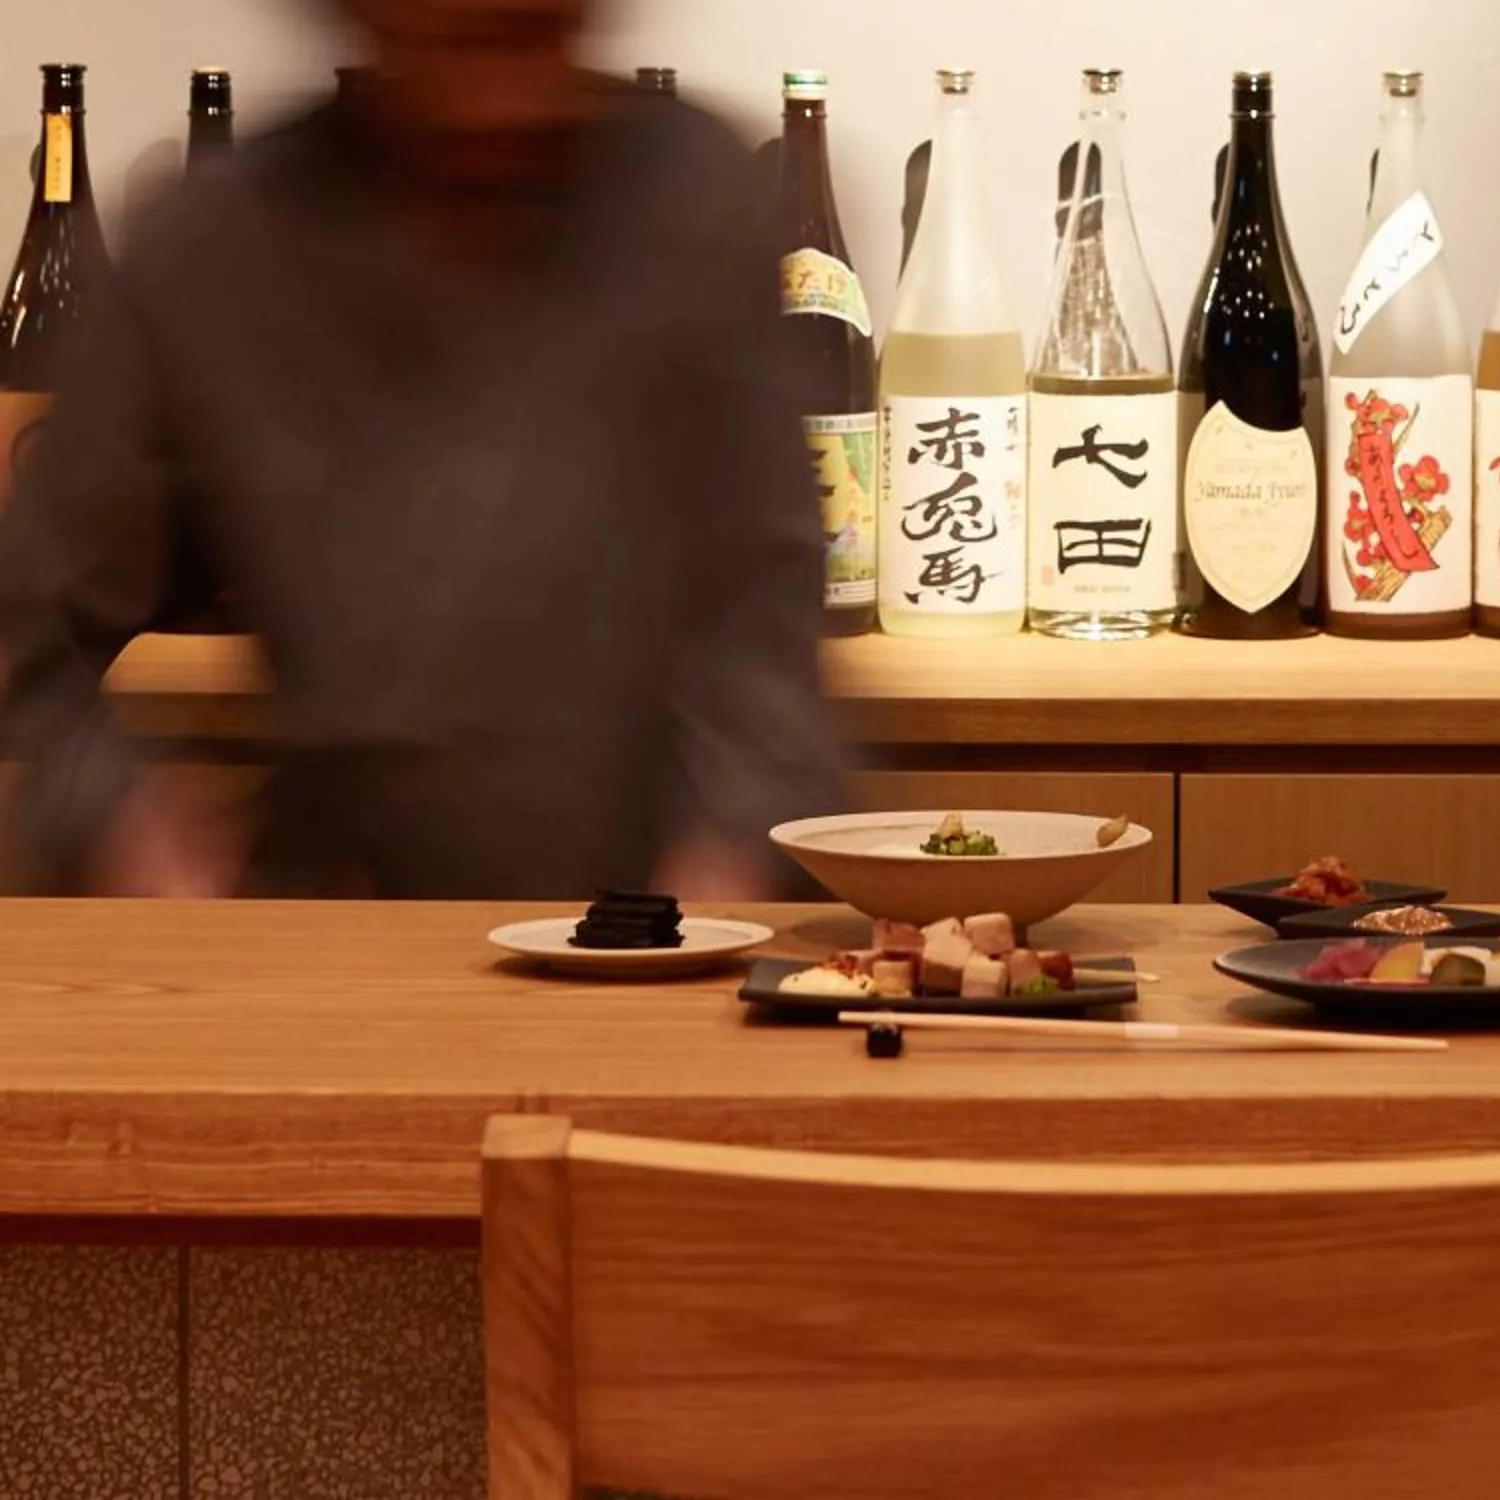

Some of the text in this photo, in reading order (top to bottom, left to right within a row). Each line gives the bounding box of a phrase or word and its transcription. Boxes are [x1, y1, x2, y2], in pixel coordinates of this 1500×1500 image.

[900, 406, 1003, 605] 赤兎馬
[1051, 423, 1152, 575] 七田
